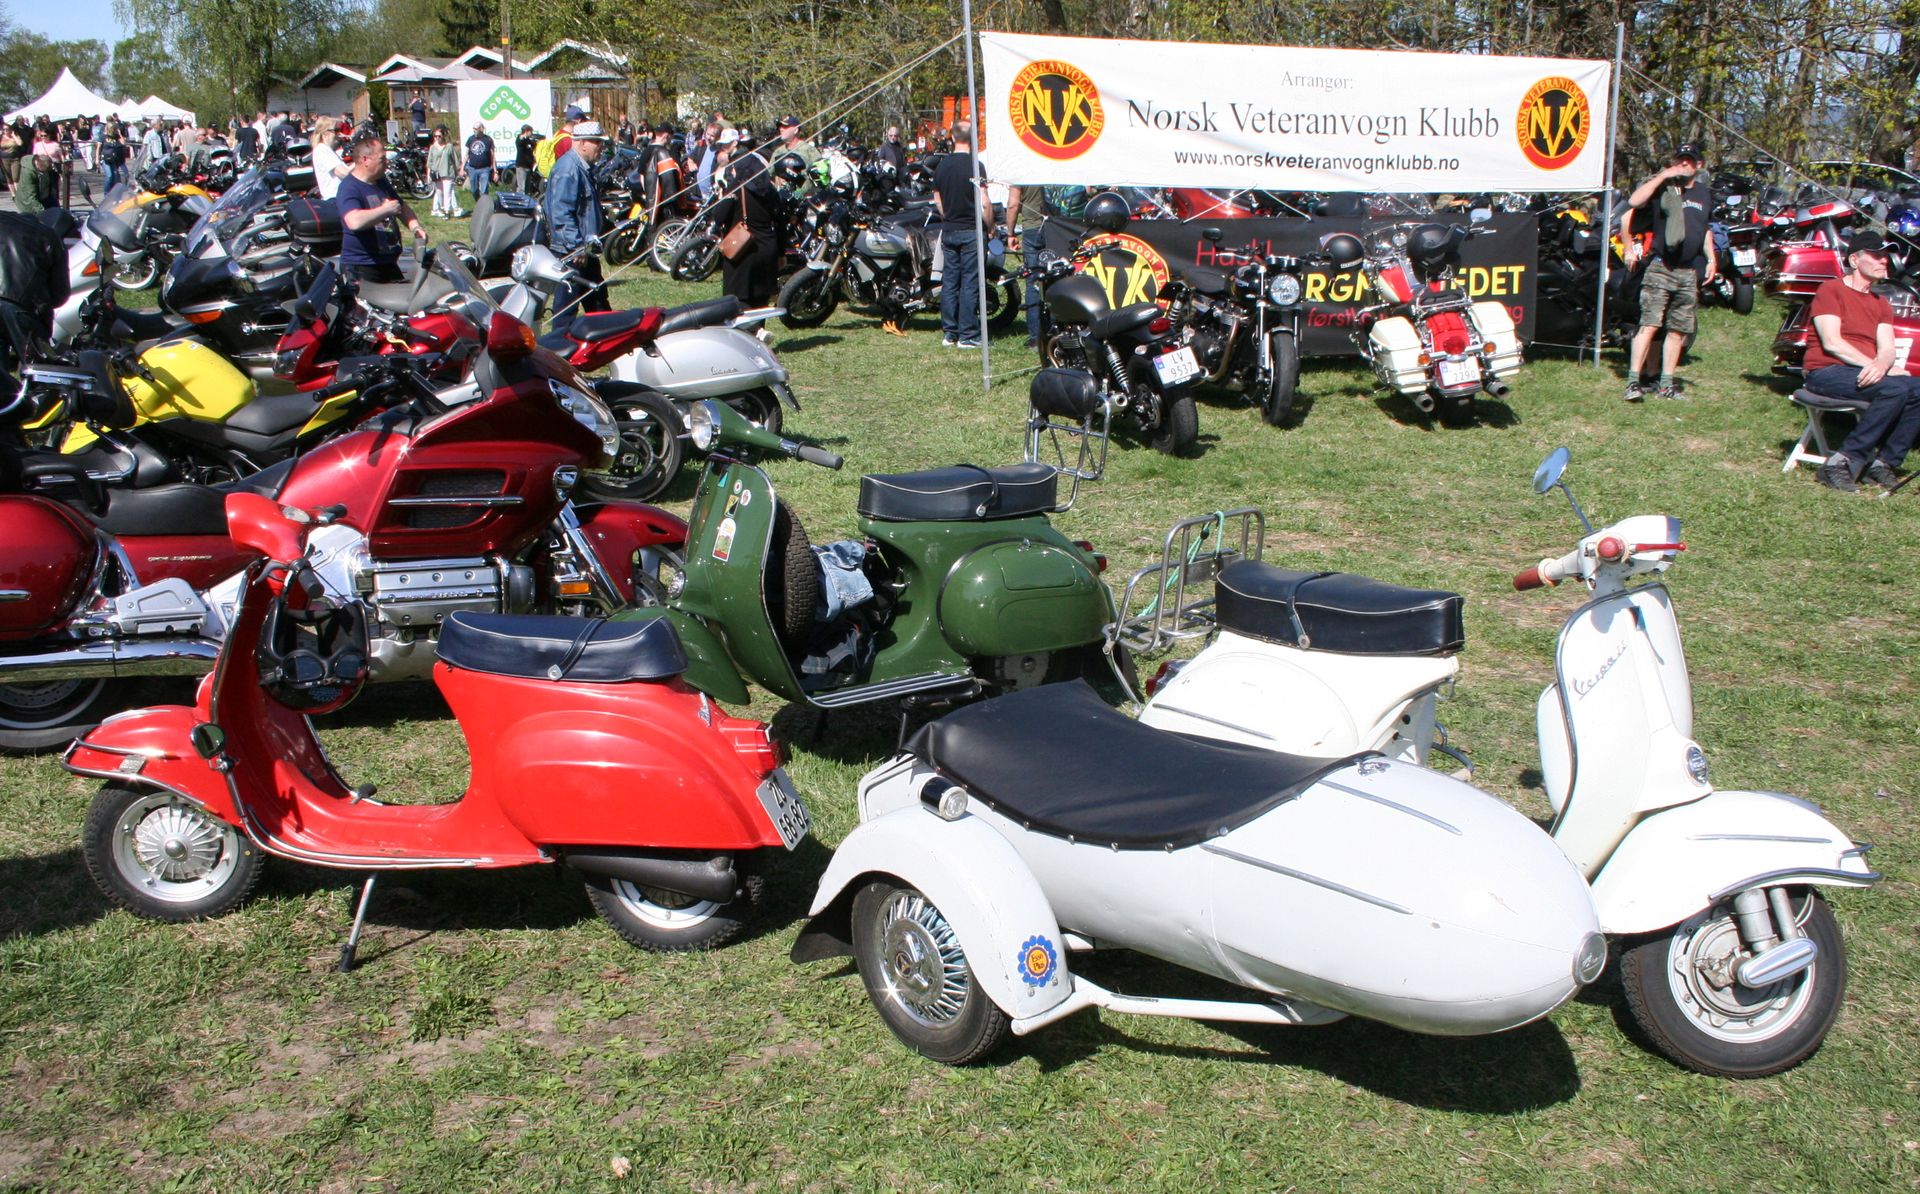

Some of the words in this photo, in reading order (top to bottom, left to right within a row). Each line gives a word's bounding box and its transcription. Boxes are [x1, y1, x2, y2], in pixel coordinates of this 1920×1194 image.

[1015, 61, 1095, 96] VETERANVOGN
[1281, 71, 1353, 92] Arrangør:
[1010, 88, 1027, 137] NORSK
[1126, 99, 1219, 132] Norsk
[1230, 102, 1408, 144] Veteranvogn
[1417, 106, 1500, 138] Klubb
[1174, 150, 1460, 175] www.norskveteranvognklubb.no
[1170, 361, 1193, 378] 9537
[1171, 351, 1184, 364] LV
[778, 799, 810, 844] 68-82
